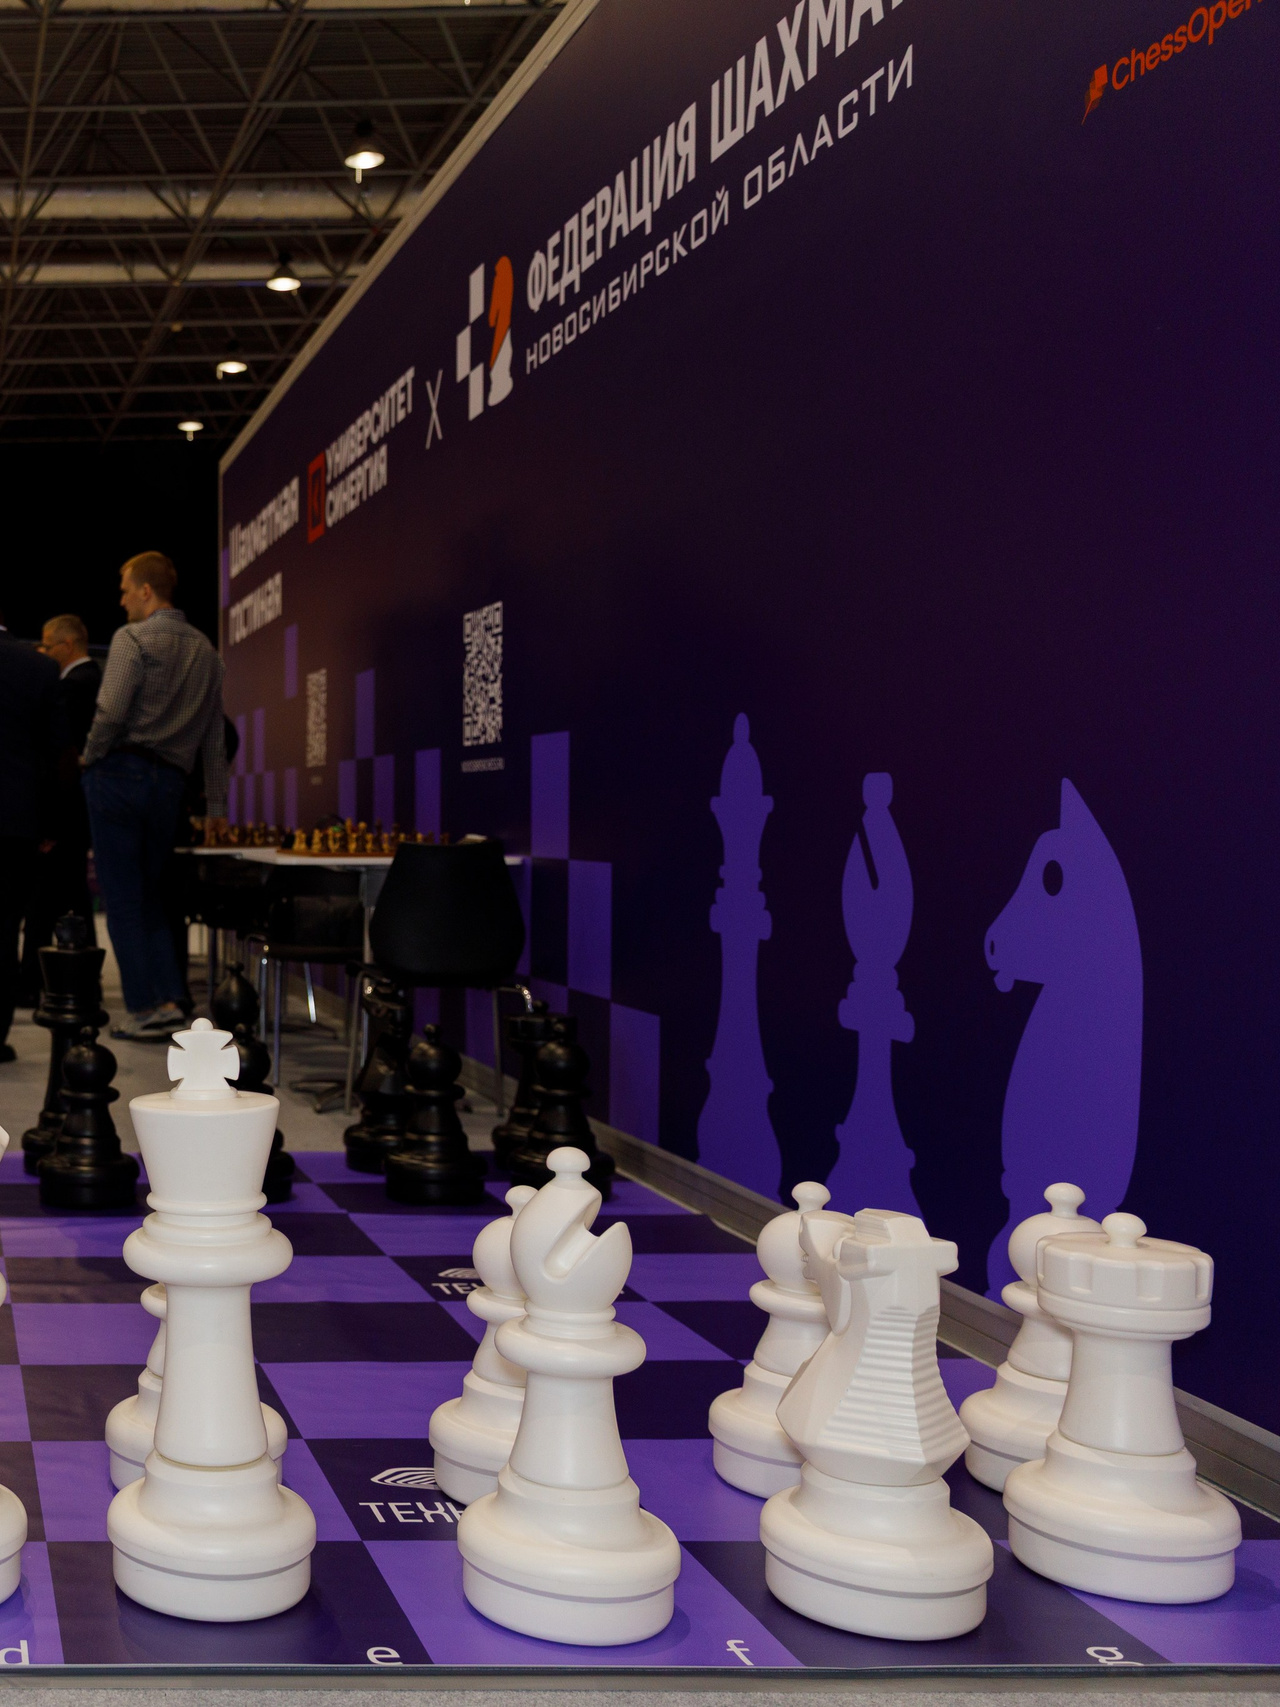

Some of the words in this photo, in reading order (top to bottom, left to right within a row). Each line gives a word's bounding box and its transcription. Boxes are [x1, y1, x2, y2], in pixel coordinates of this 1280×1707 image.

[526, 101, 697, 314] ФЕДЕРАЦИЯ
[710, 0, 904, 164] ШАХМ
[526, 186, 730, 375] НОВОСИБИРСКОЙ
[743, 43, 914, 210] ОБЛАСТИ
[325, 366, 415, 485] УНИВЕРСИТЕТ
[325, 443, 388, 529] СИНЕРГИЯ
[366, 1646, 404, 1666] e
[726, 1639, 755, 1666] f
